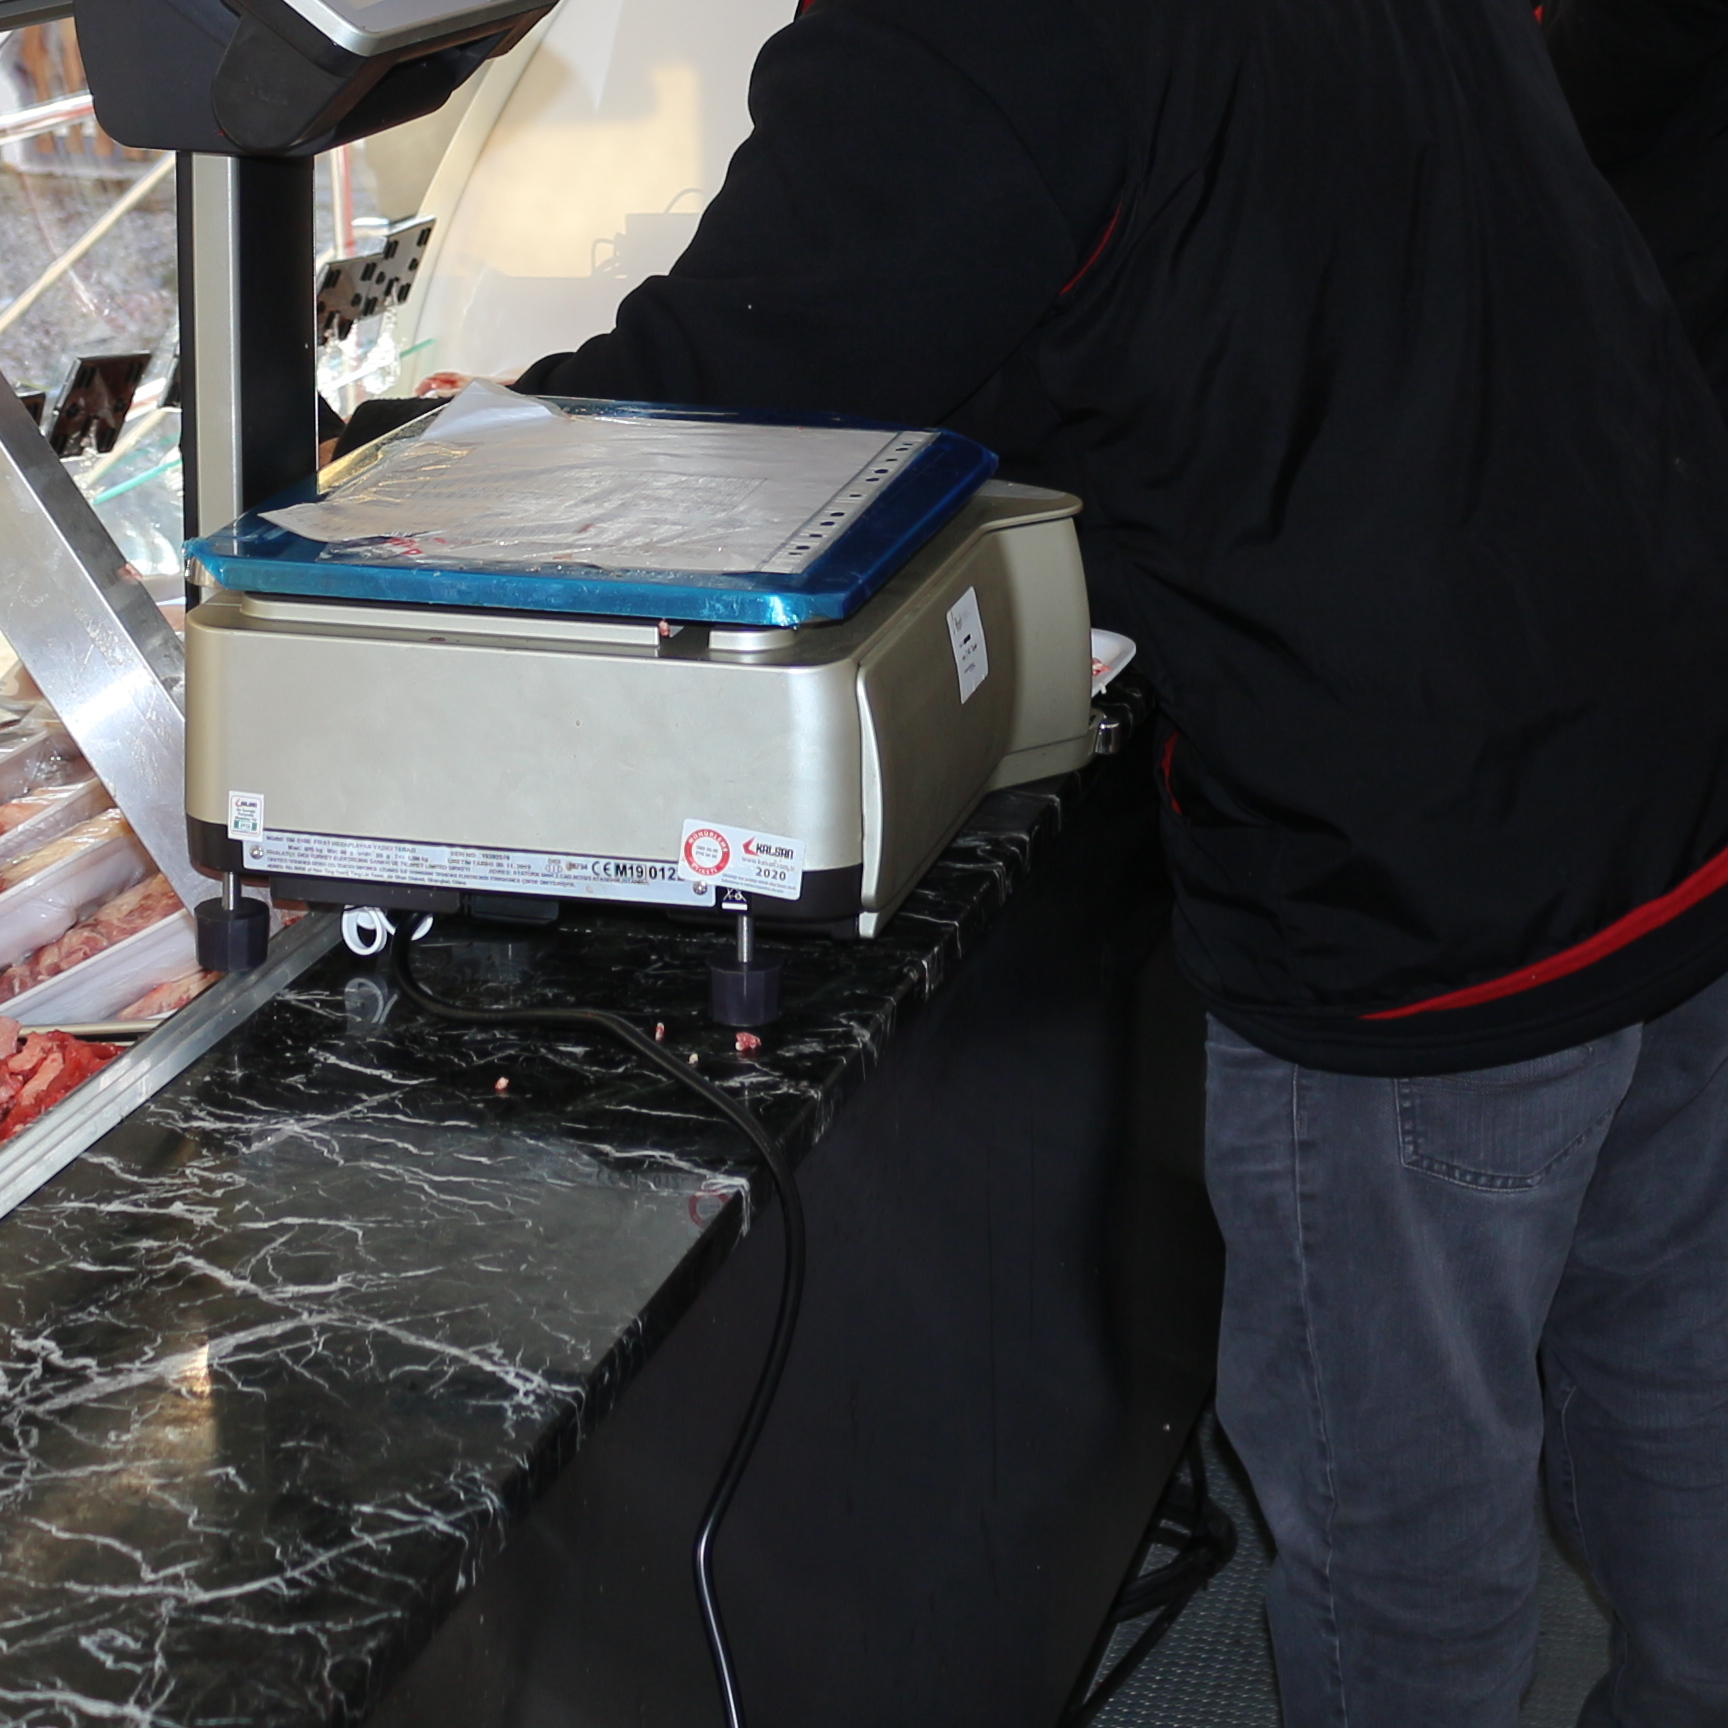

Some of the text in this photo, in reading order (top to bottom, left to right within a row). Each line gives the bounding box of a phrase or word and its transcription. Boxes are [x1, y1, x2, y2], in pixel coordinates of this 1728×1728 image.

[756, 842, 795, 860] KALSAN
[615, 864, 645, 879] M19
[649, 865, 686, 882] 012
[755, 867, 786, 881] 2020
